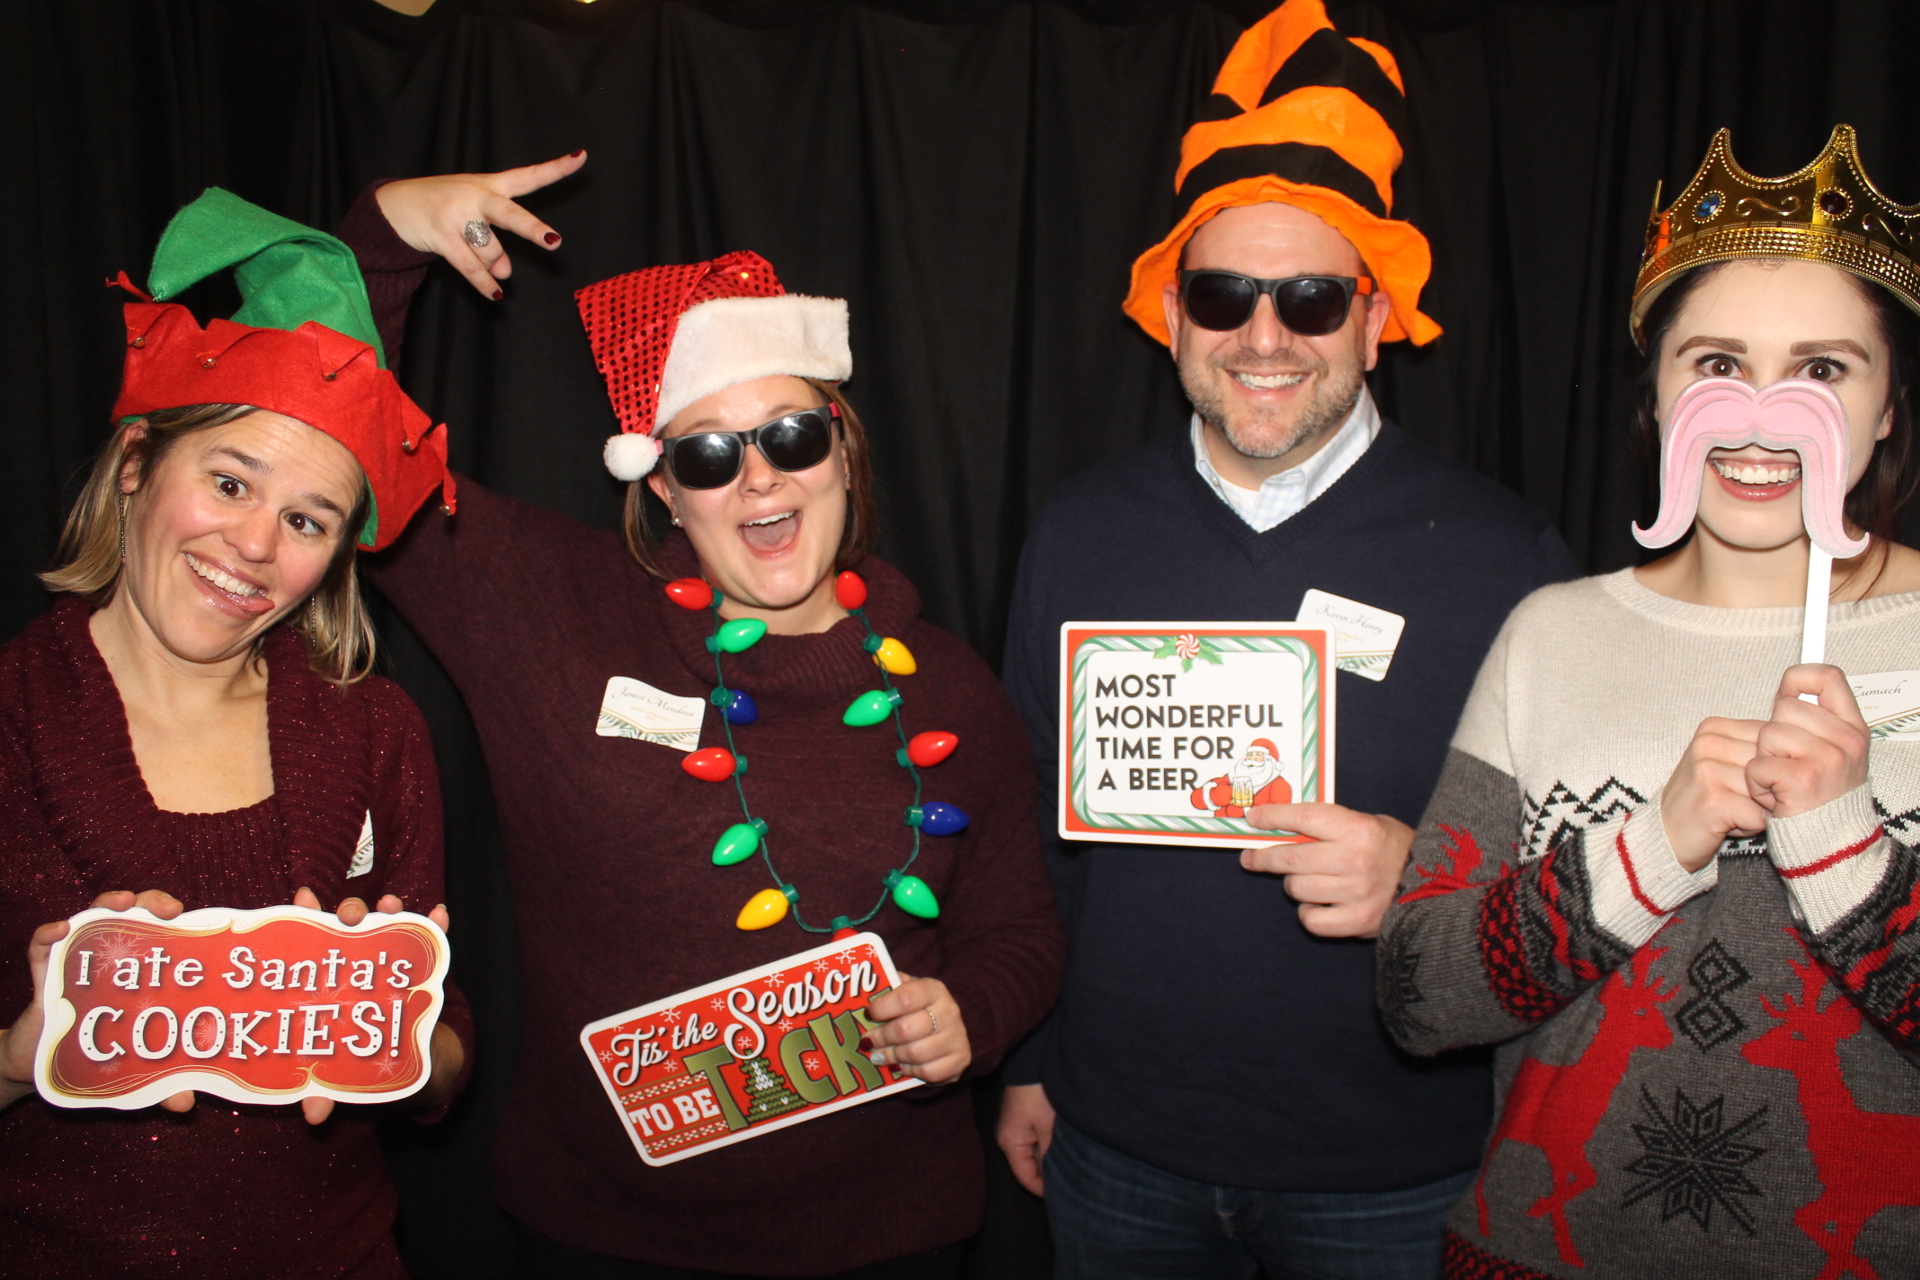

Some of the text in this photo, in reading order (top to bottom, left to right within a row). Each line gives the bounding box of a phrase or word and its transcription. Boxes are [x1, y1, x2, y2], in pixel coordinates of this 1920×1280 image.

[1316, 603, 1384, 635] Kevin Henry
[1095, 673, 1176, 698] MOST
[1853, 680, 1908, 698] Zumach
[611, 687, 646, 700] Janice
[647, 697, 695, 717] Mendoza
[1095, 704, 1283, 729] WONDERFUL
[1096, 736, 1235, 760] TIME FOR
[1097, 768, 1199, 791] A BEER
[75, 946, 413, 991] I ate Santa's
[671, 1012, 719, 1050] the
[723, 960, 878, 1060] Season
[78, 999, 403, 1062] COOKIES!
[628, 1102, 675, 1137] TO
[672, 1087, 721, 1125] BE
